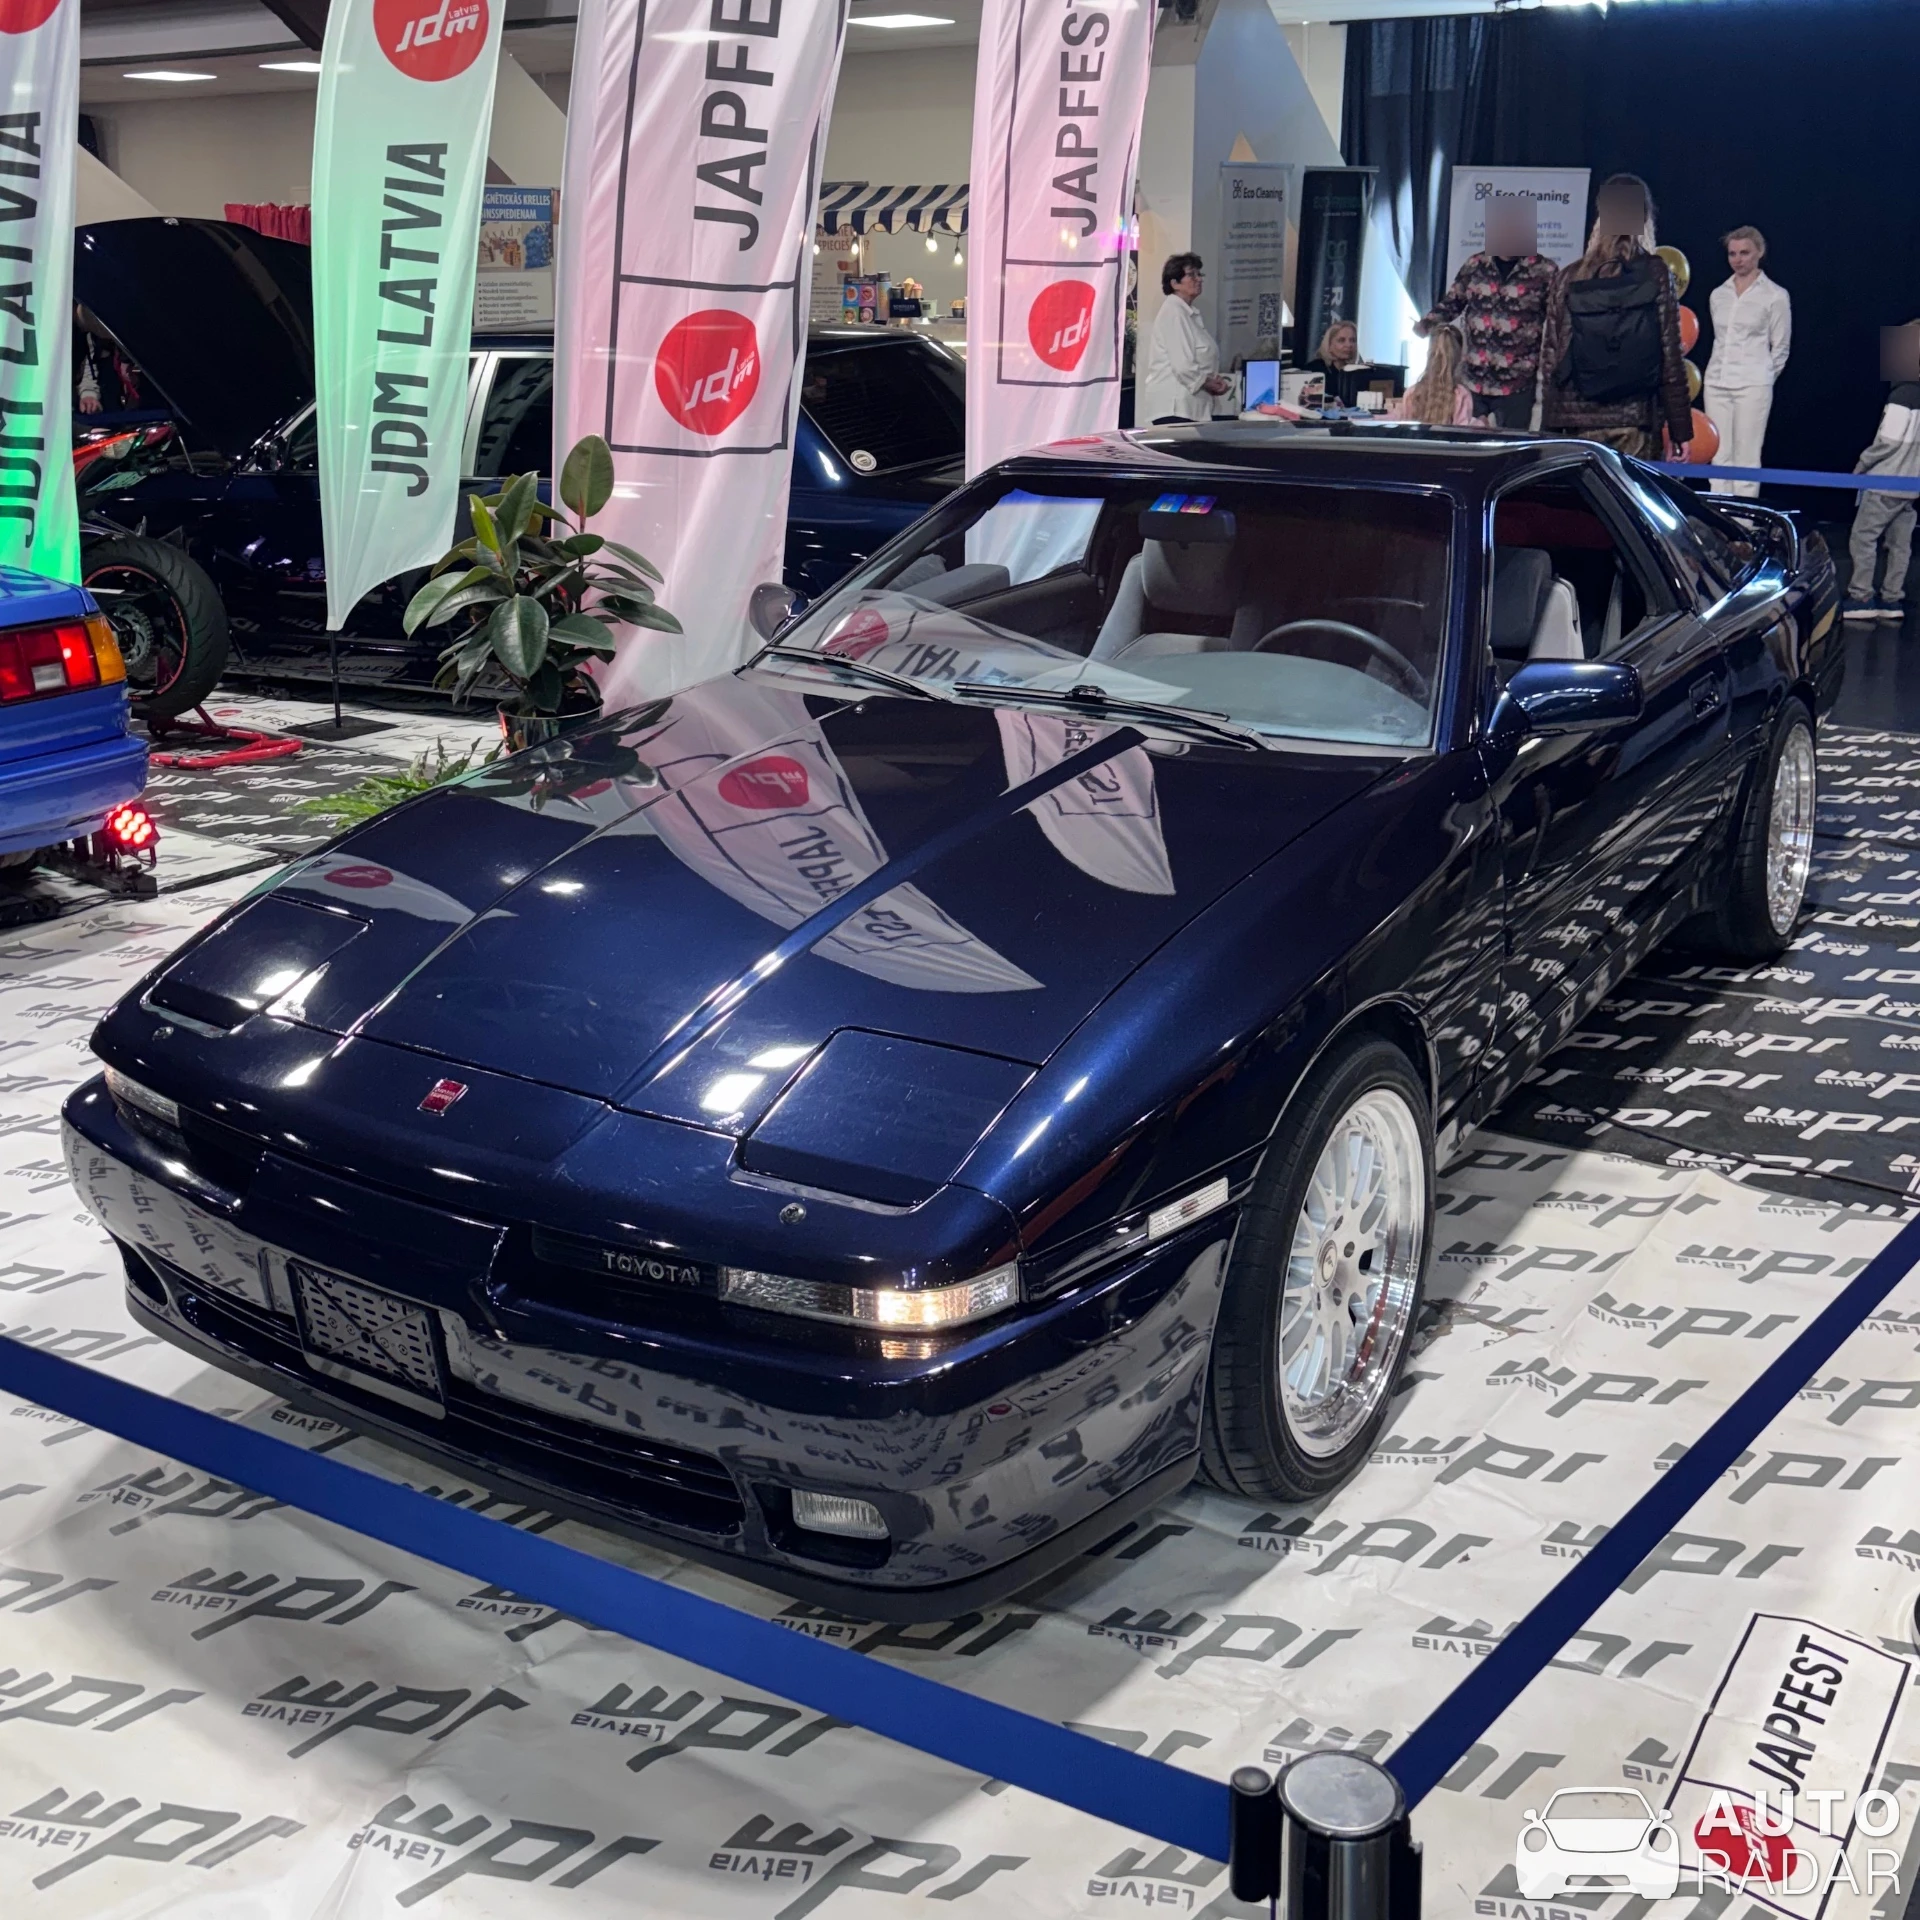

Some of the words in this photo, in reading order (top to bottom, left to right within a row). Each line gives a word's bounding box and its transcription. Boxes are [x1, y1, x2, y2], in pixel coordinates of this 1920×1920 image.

[693, 0, 782, 251] JAPFE
[1050, 0, 1111, 238] JAPFES
[523, 194, 551, 206] KRELLES
[1243, 188, 1255, 199] Eco
[1256, 187, 1284, 202] Cleaning
[377, 143, 449, 348] LATVIA
[371, 371, 430, 498] JDM
[1687, 1037, 1746, 1048] Latvia
[1614, 1075, 1674, 1084] Latvia
[1814, 1077, 1876, 1088] Latvia
[1534, 1113, 1596, 1124] Latvia
[1743, 1115, 1808, 1127] Latvia
[1665, 1158, 1732, 1172] Latvia
[1532, 1201, 1600, 1213] Latvia
[1757, 1205, 1828, 1218] Latvia
[603, 1250, 701, 1287] TOYOTA
[1438, 1254, 1509, 1267] Latvia
[1675, 1256, 1748, 1272] Latvia
[1587, 1304, 1660, 1332] Latvia
[1485, 1374, 1560, 1398] Latvia
[1368, 1455, 1451, 1466] Latvia
[1237, 1536, 1324, 1557] Latvia
[151, 1589, 238, 1614] Latvia
[456, 1597, 545, 1621] Latvia
[241, 1701, 336, 1727] Latvia
[1748, 1634, 1849, 1797] JAPFEST
[570, 1713, 666, 1742] Latvia
[346, 1829, 447, 1868] Latvia
[708, 1851, 815, 1882] Latvia
[1086, 1878, 1196, 1911] Latvia
